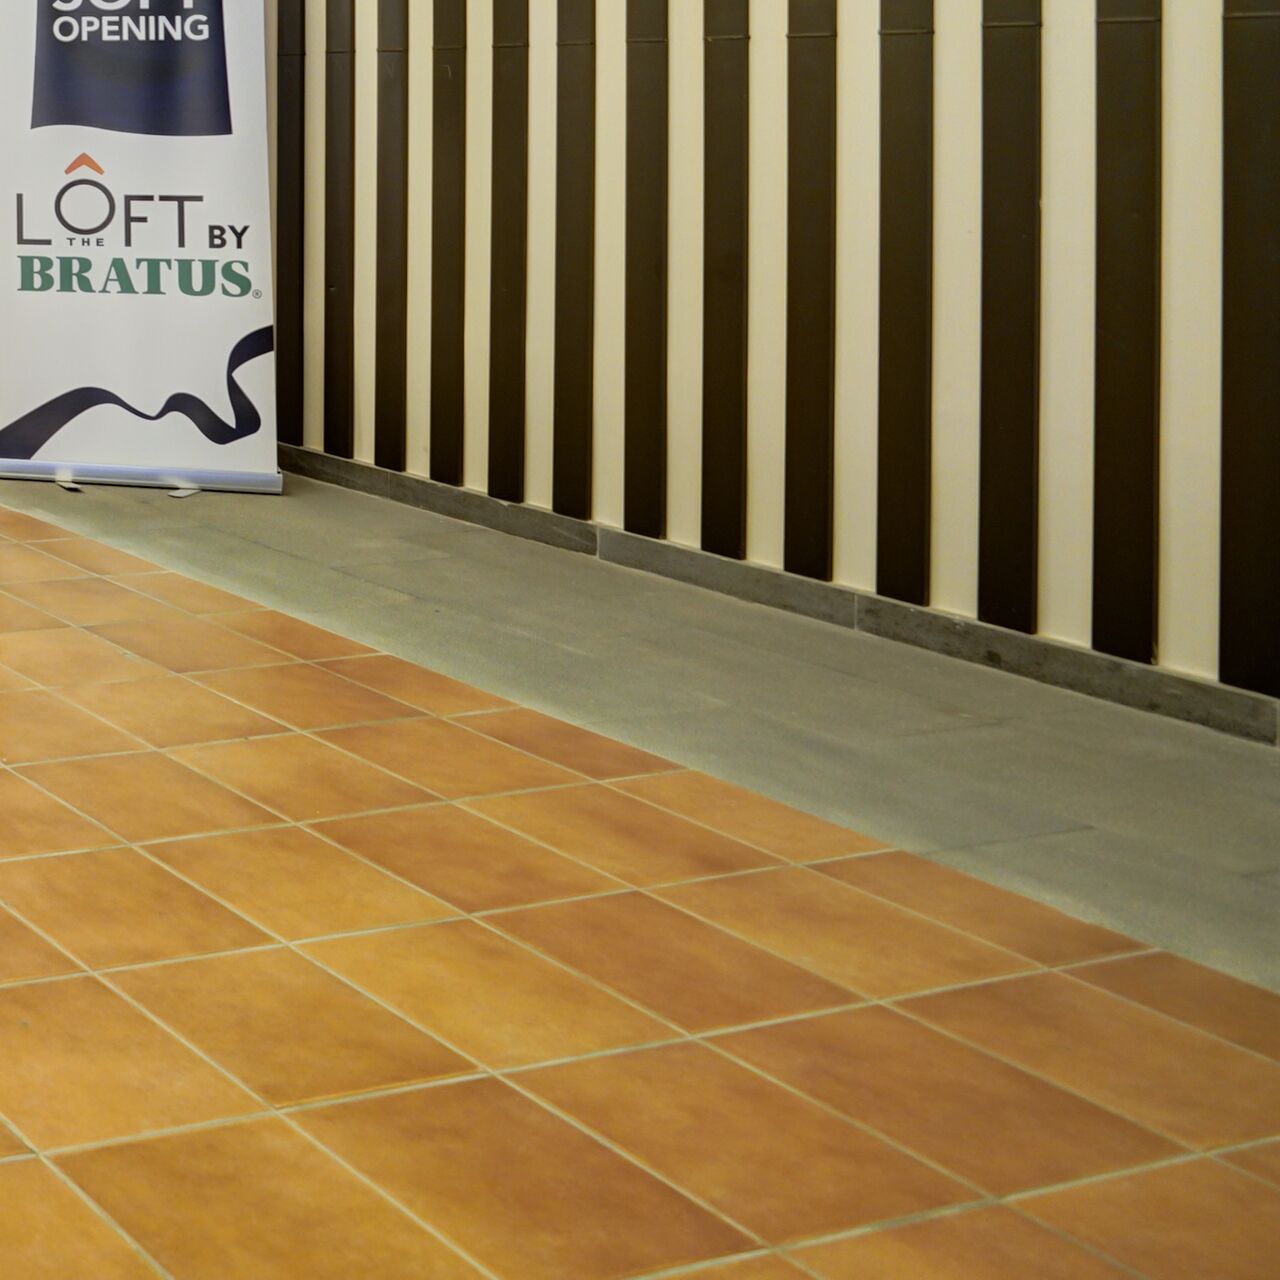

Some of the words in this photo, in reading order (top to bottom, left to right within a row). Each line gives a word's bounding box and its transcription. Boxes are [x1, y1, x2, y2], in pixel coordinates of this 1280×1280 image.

[52, 14, 210, 42] OPENING
[66, 238, 105, 247] THE
[208, 224, 250, 249] BY
